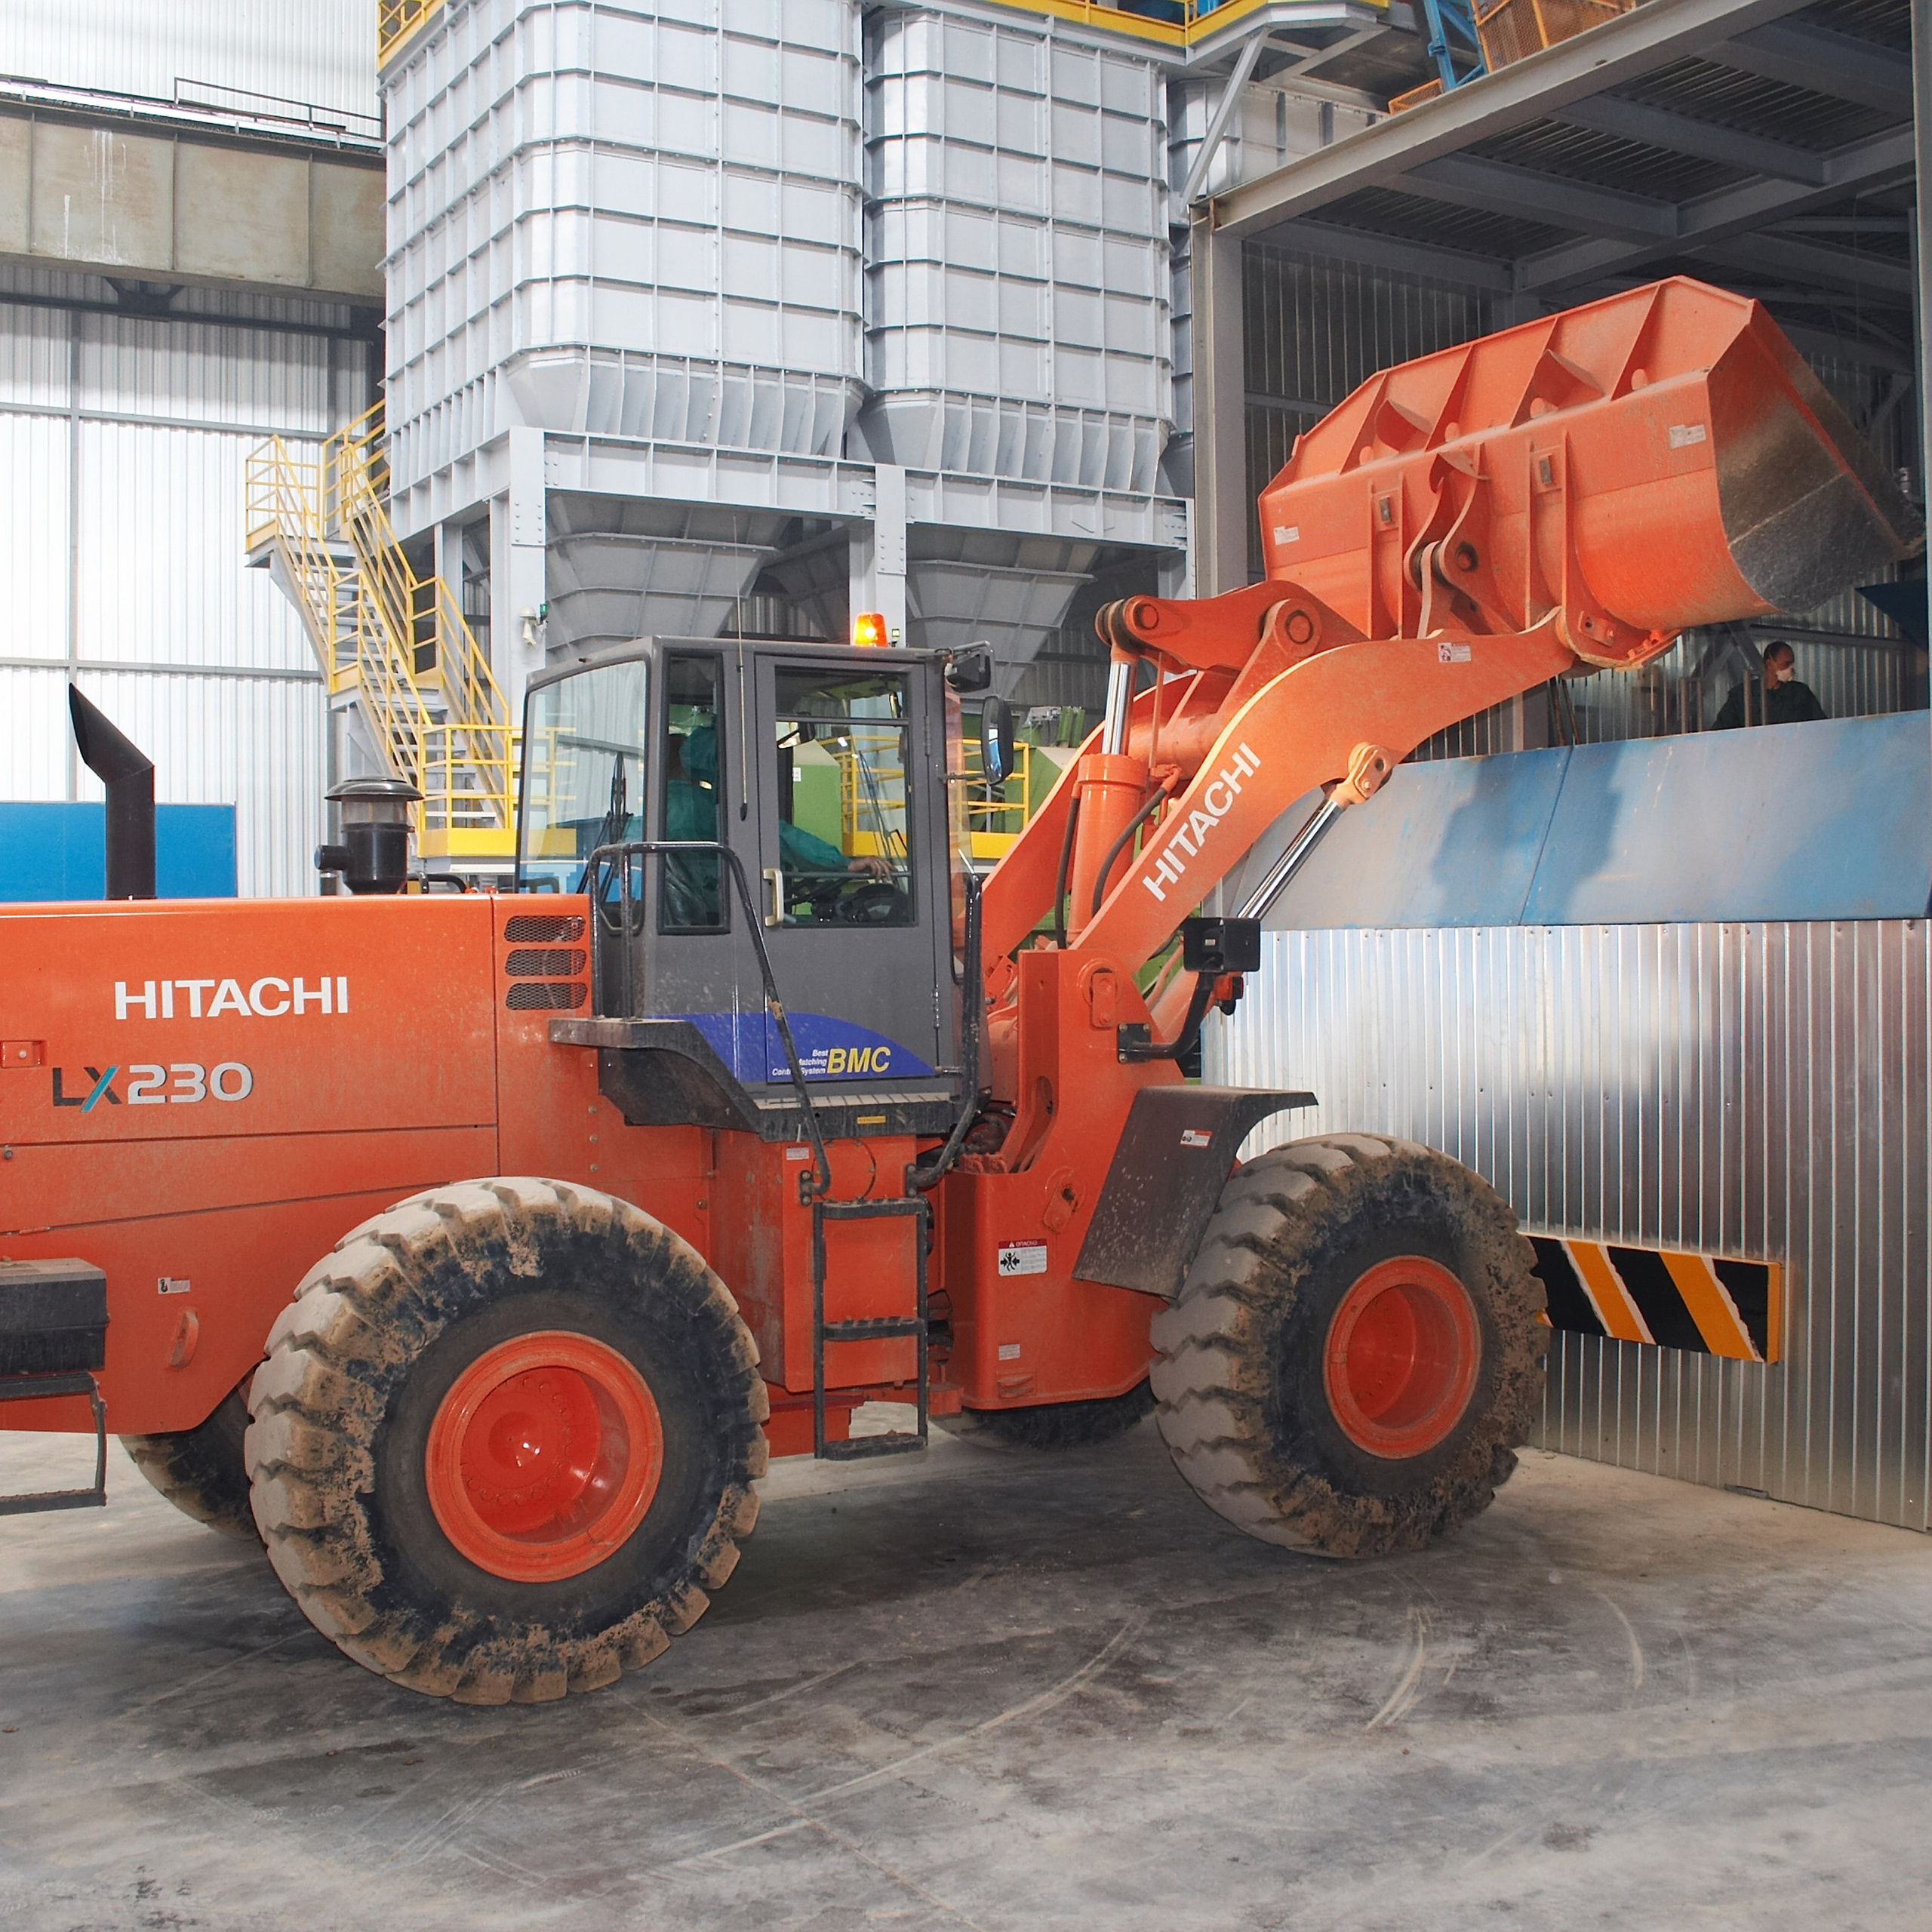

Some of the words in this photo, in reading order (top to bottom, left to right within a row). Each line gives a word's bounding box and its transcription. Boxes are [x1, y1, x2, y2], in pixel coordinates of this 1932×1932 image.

[1142, 742, 1261, 902] HITACHI
[115, 976, 349, 1020] HITACHI
[798, 1058, 827, 1066] atching
[826, 1046, 891, 1074] BMC
[52, 1062, 254, 1113] LX230
